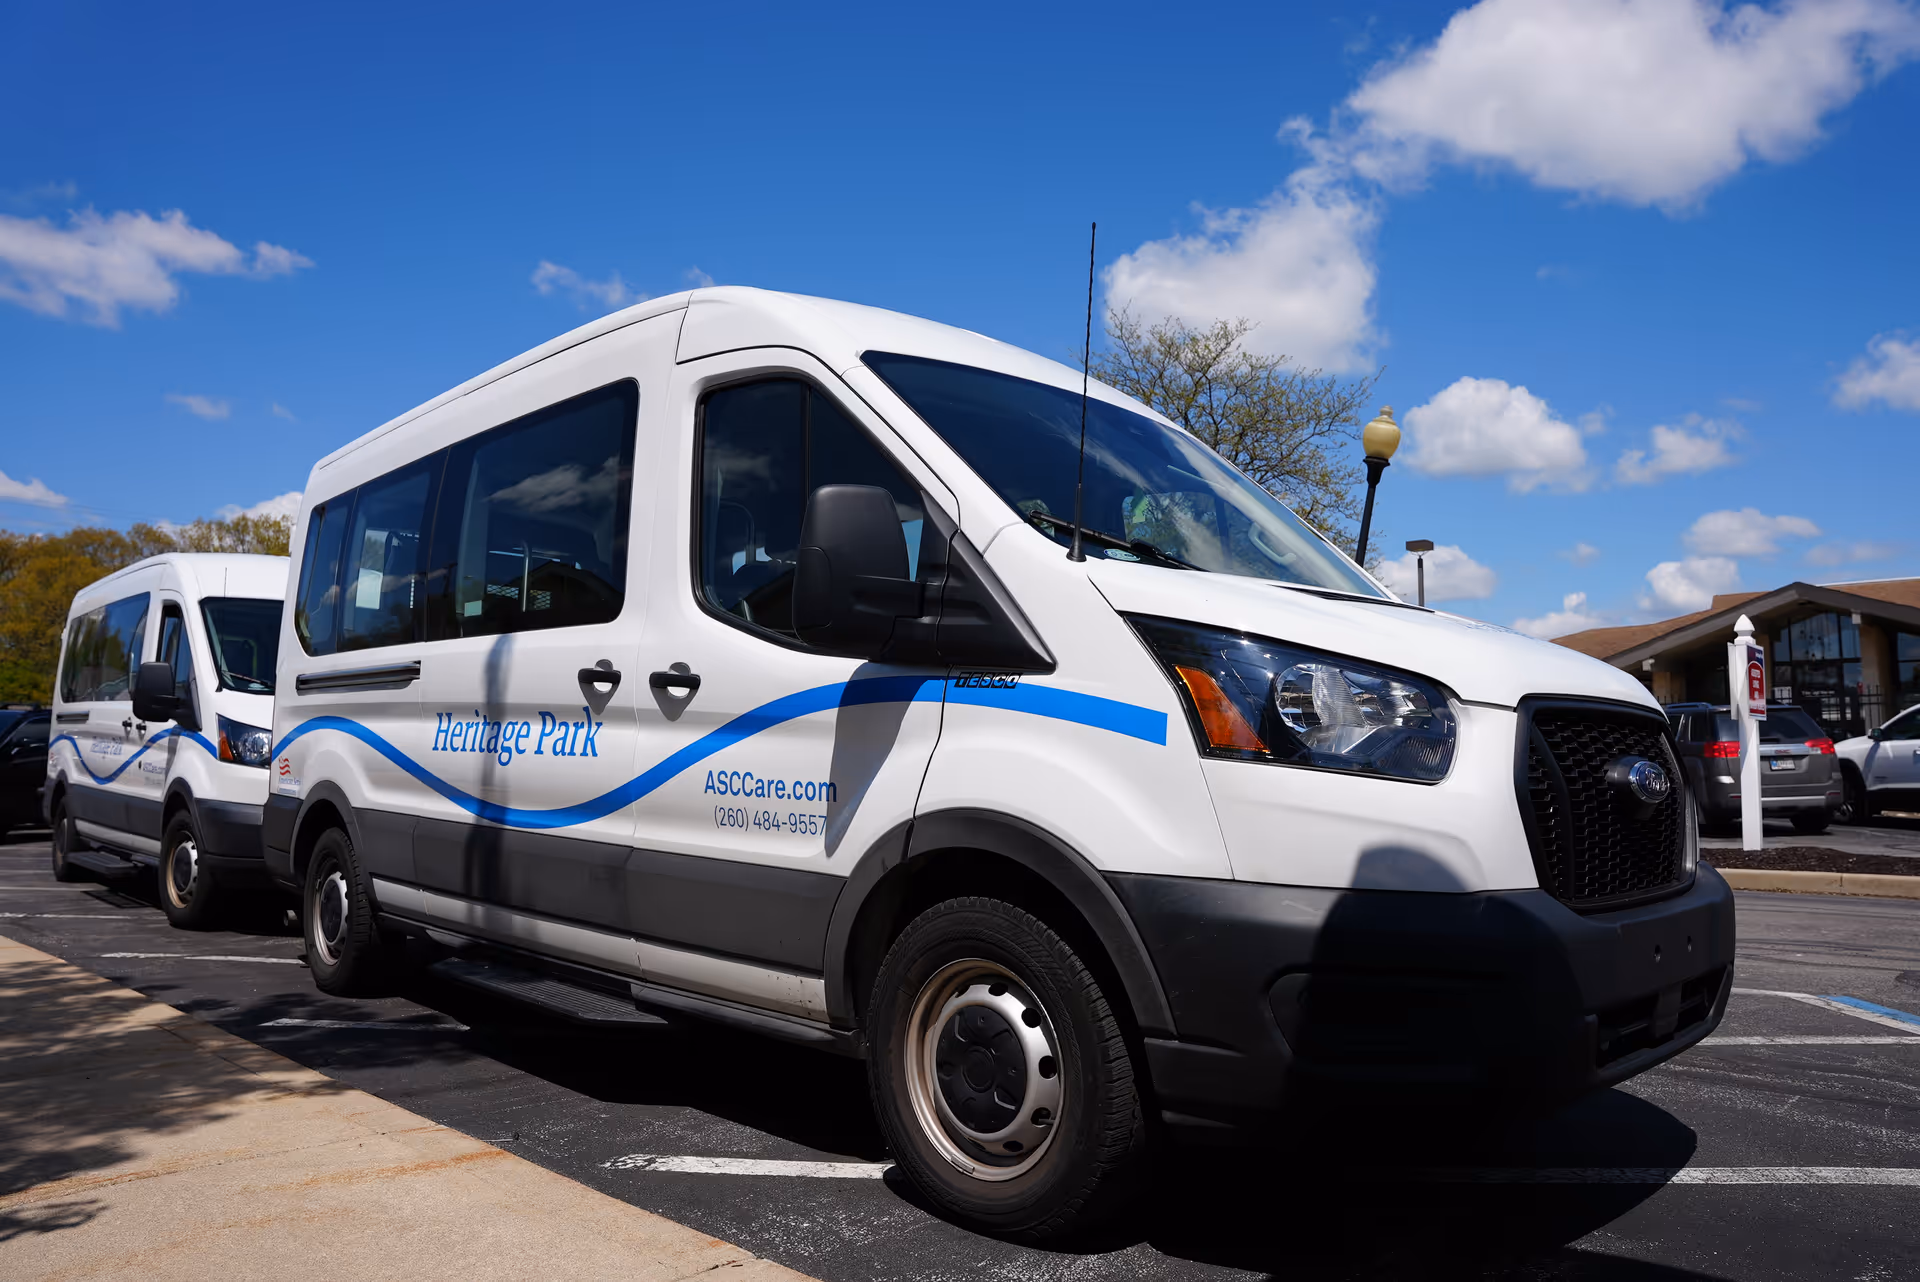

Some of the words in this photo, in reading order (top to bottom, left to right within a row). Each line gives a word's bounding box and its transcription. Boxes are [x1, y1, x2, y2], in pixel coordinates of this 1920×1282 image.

[954, 672, 1023, 689] TESCO
[432, 709, 531, 766] Heritage
[534, 706, 603, 757] Park
[704, 770, 837, 802] ASCCare.com
[714, 805, 749, 831] (260)
[753, 810, 827, 836] 484-9557
